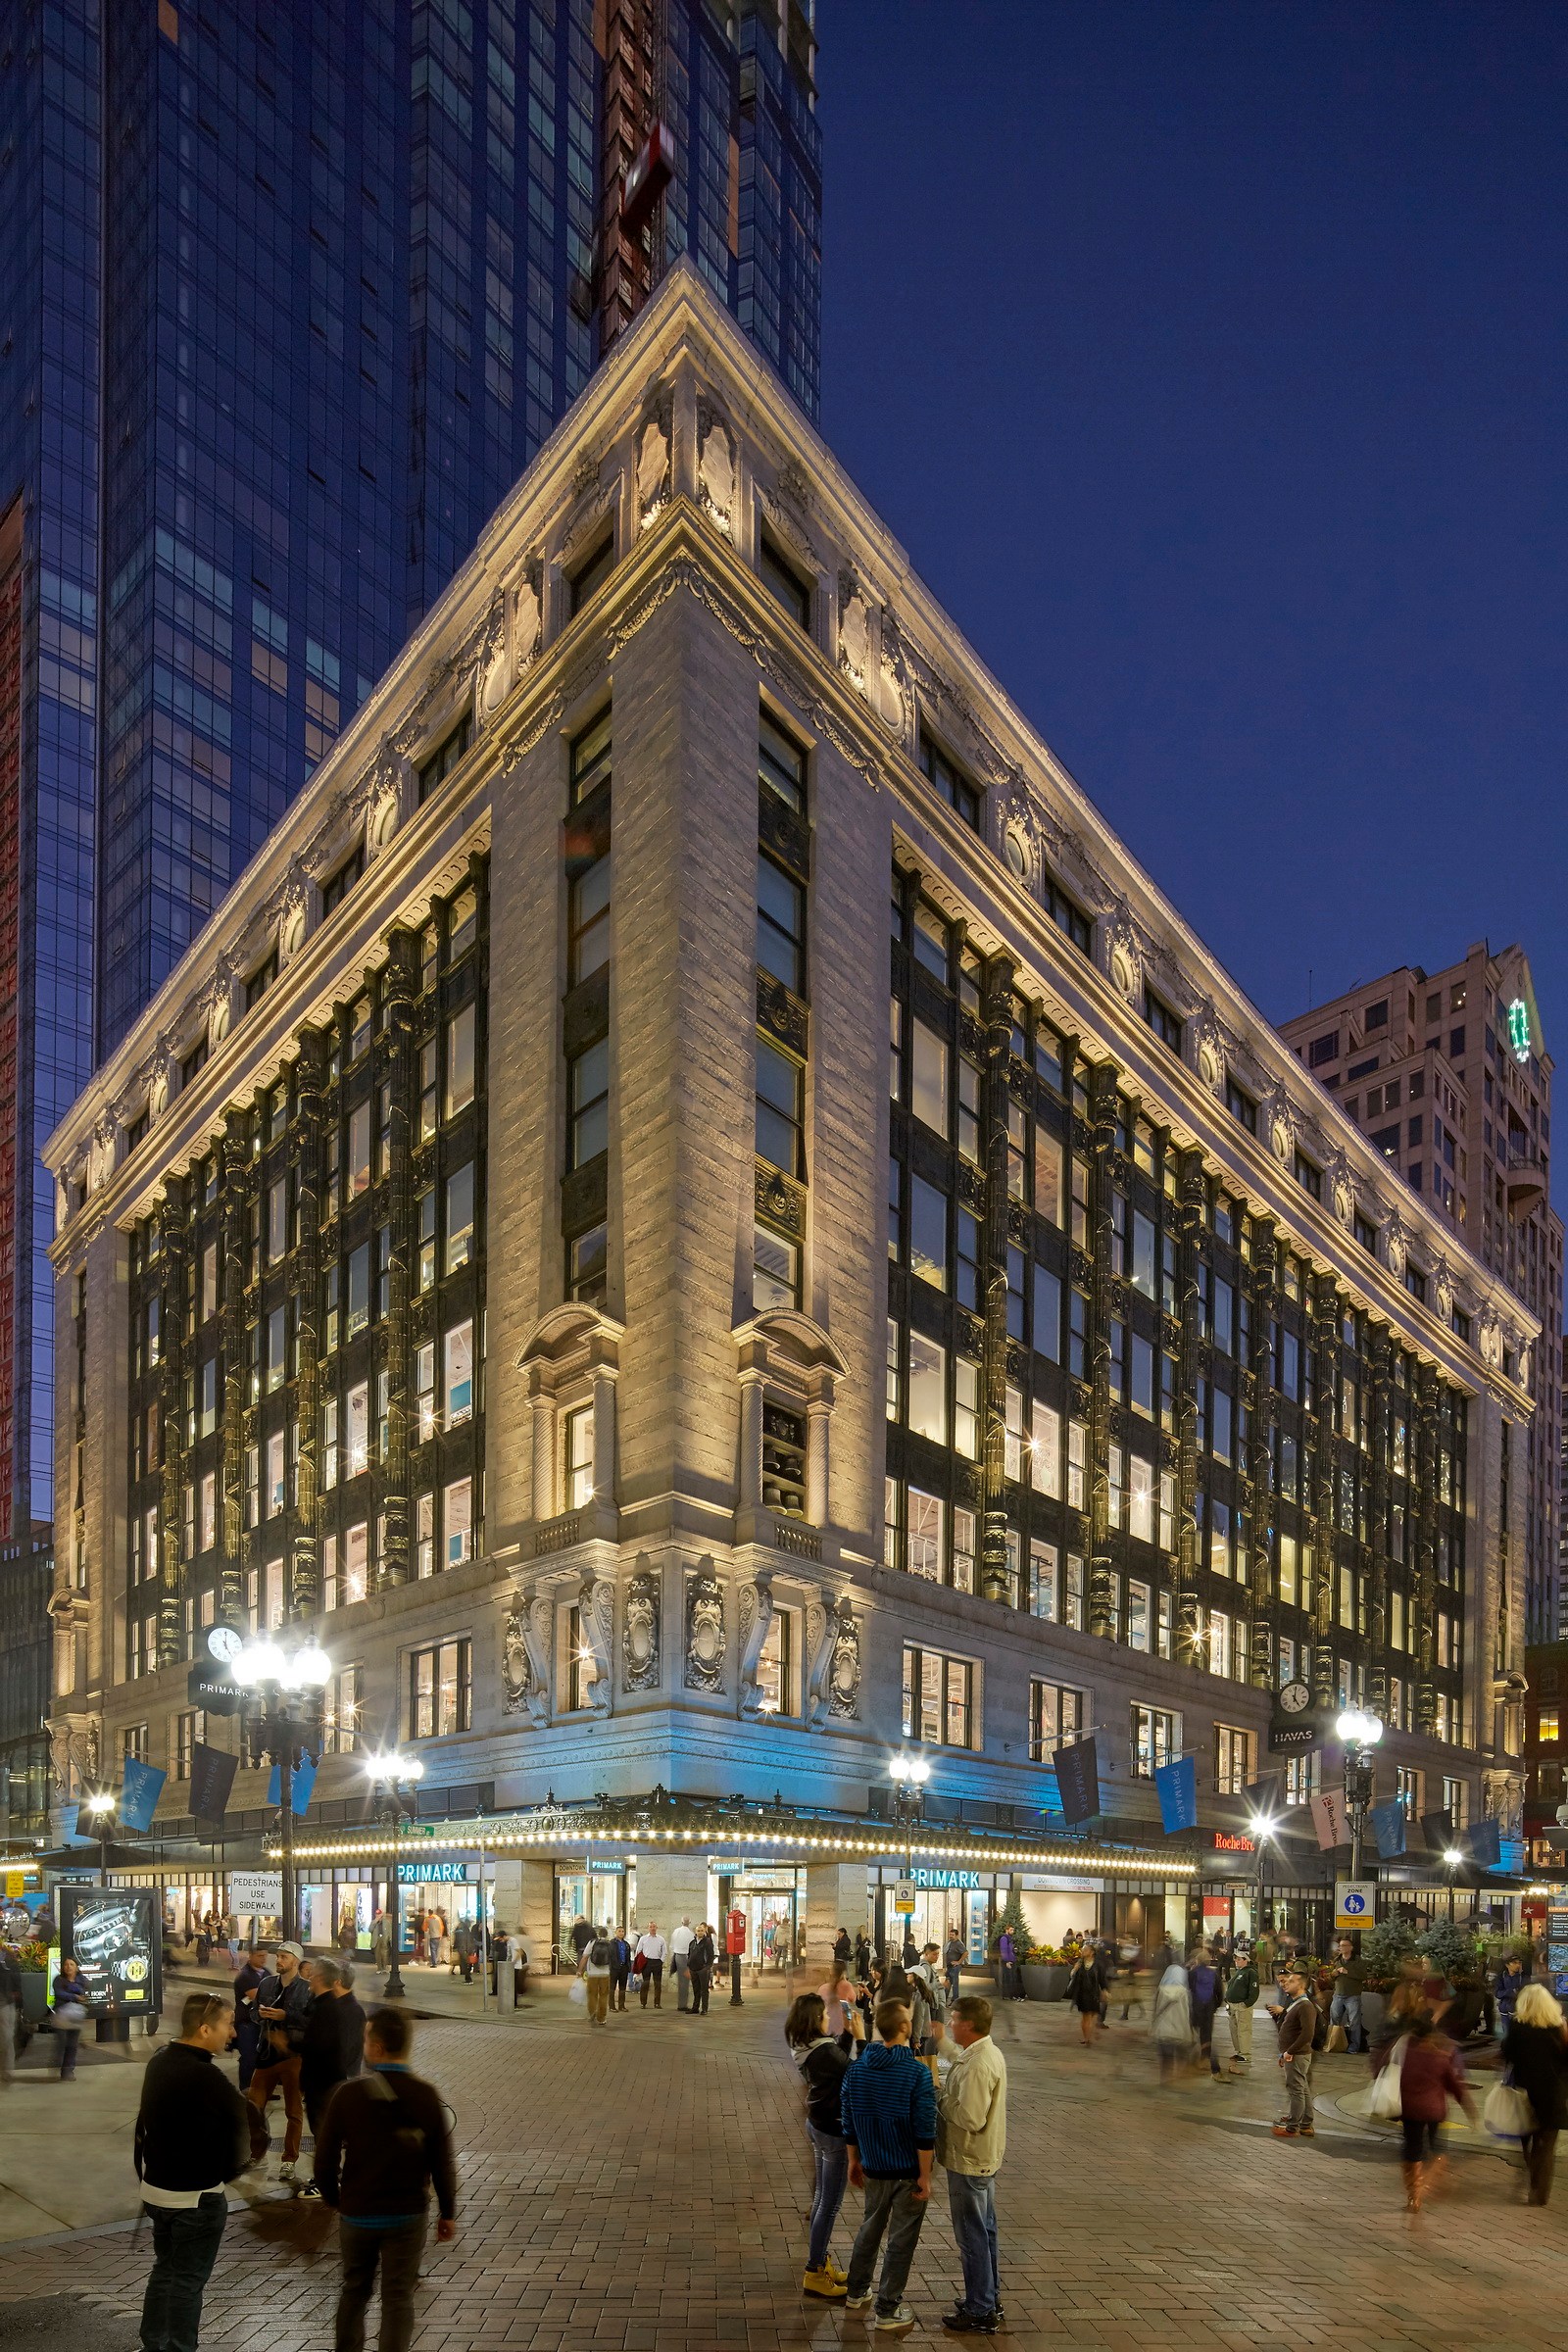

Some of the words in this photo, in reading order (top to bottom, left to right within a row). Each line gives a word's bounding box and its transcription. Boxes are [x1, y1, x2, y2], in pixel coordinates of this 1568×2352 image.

[1275, 1730, 1312, 1742] HAVAS
[200, 1756, 220, 1811] PRIMARK
[1071, 1752, 1088, 1812] PRIMARK
[125, 1771, 147, 1820] PRIMARK
[1170, 1770, 1185, 1823] PRIMARK
[398, 1863, 463, 1882] PRIMARK
[592, 1861, 622, 1870] PRIMARK
[233, 1878, 283, 1888] PEDESTRIANS
[910, 1868, 979, 1887] PRIMARK
[250, 1889, 266, 1898] USE
[239, 1901, 275, 1910] SIDEWALK
